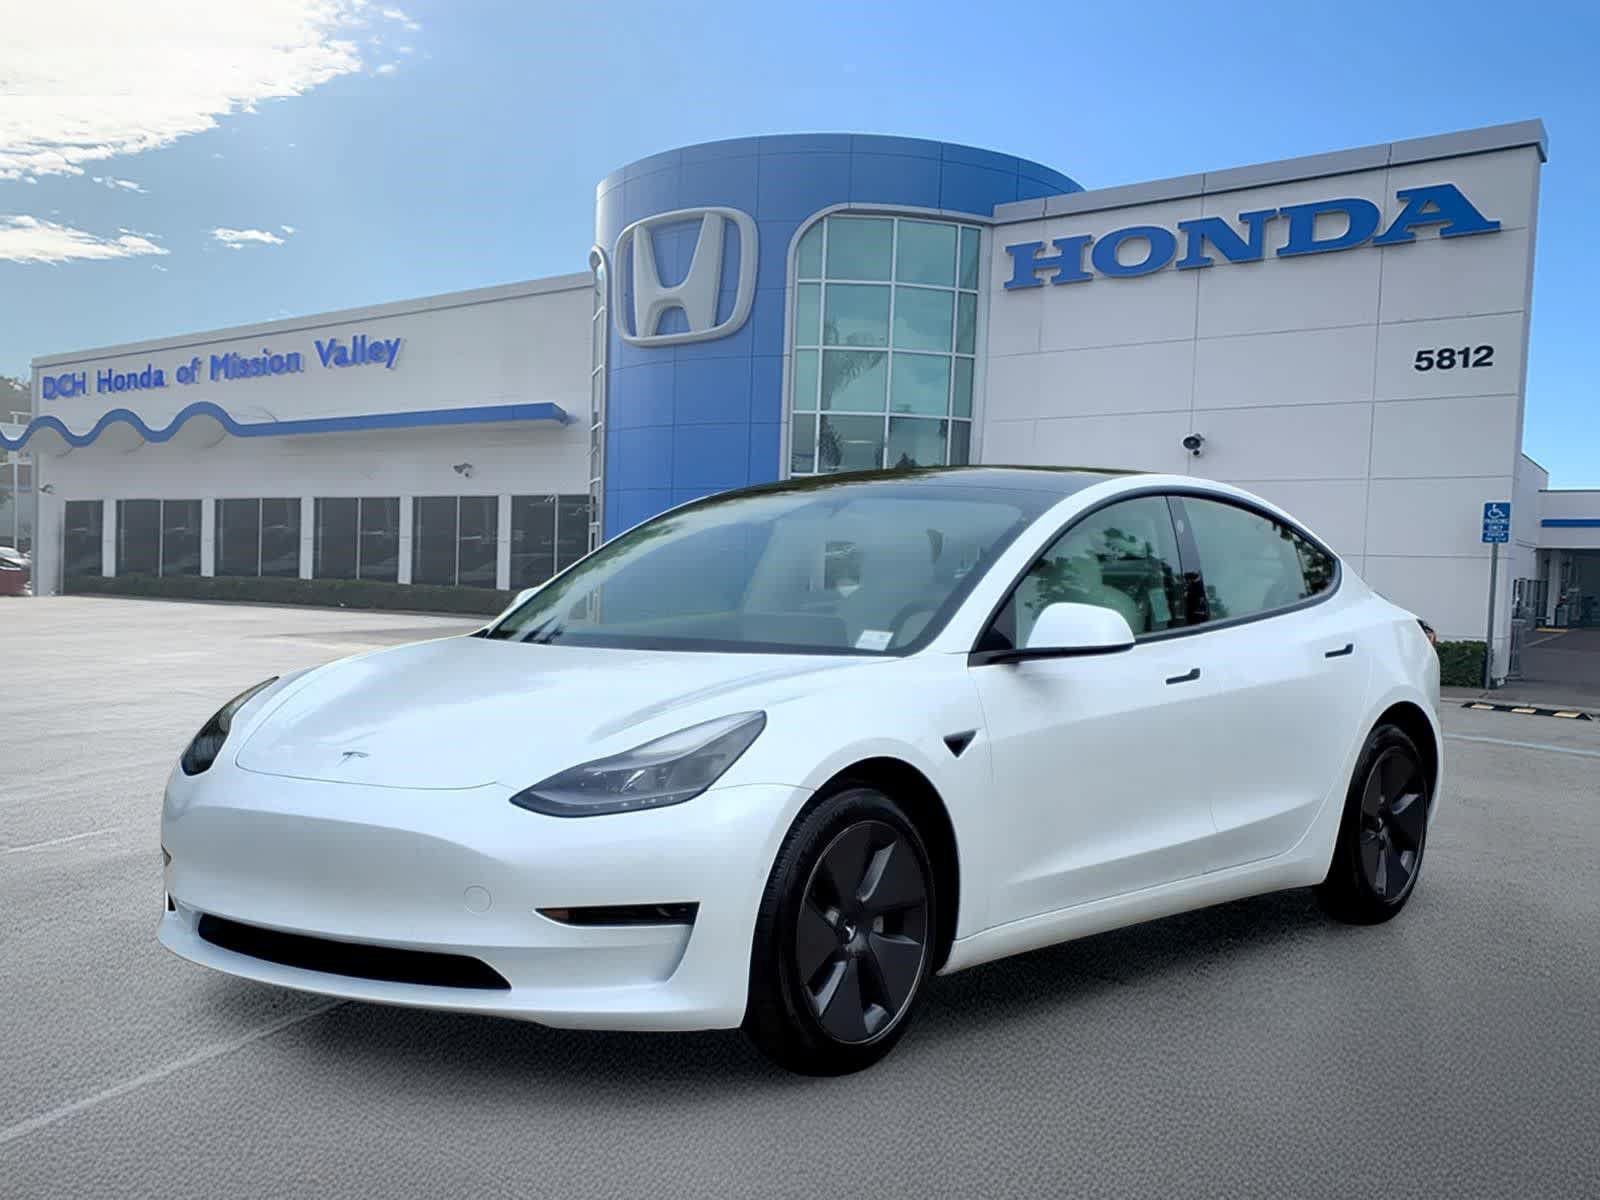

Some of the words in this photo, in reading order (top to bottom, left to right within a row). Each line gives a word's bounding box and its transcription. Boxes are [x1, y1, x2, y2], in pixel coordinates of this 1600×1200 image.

[1003, 183, 1501, 291] HONDA
[43, 371, 87, 400] DCH
[97, 363, 166, 393] Honda
[176, 357, 200, 384] of
[210, 348, 301, 381] Mission
[315, 334, 401, 369] Valley
[1414, 345, 1494, 372] 5812
